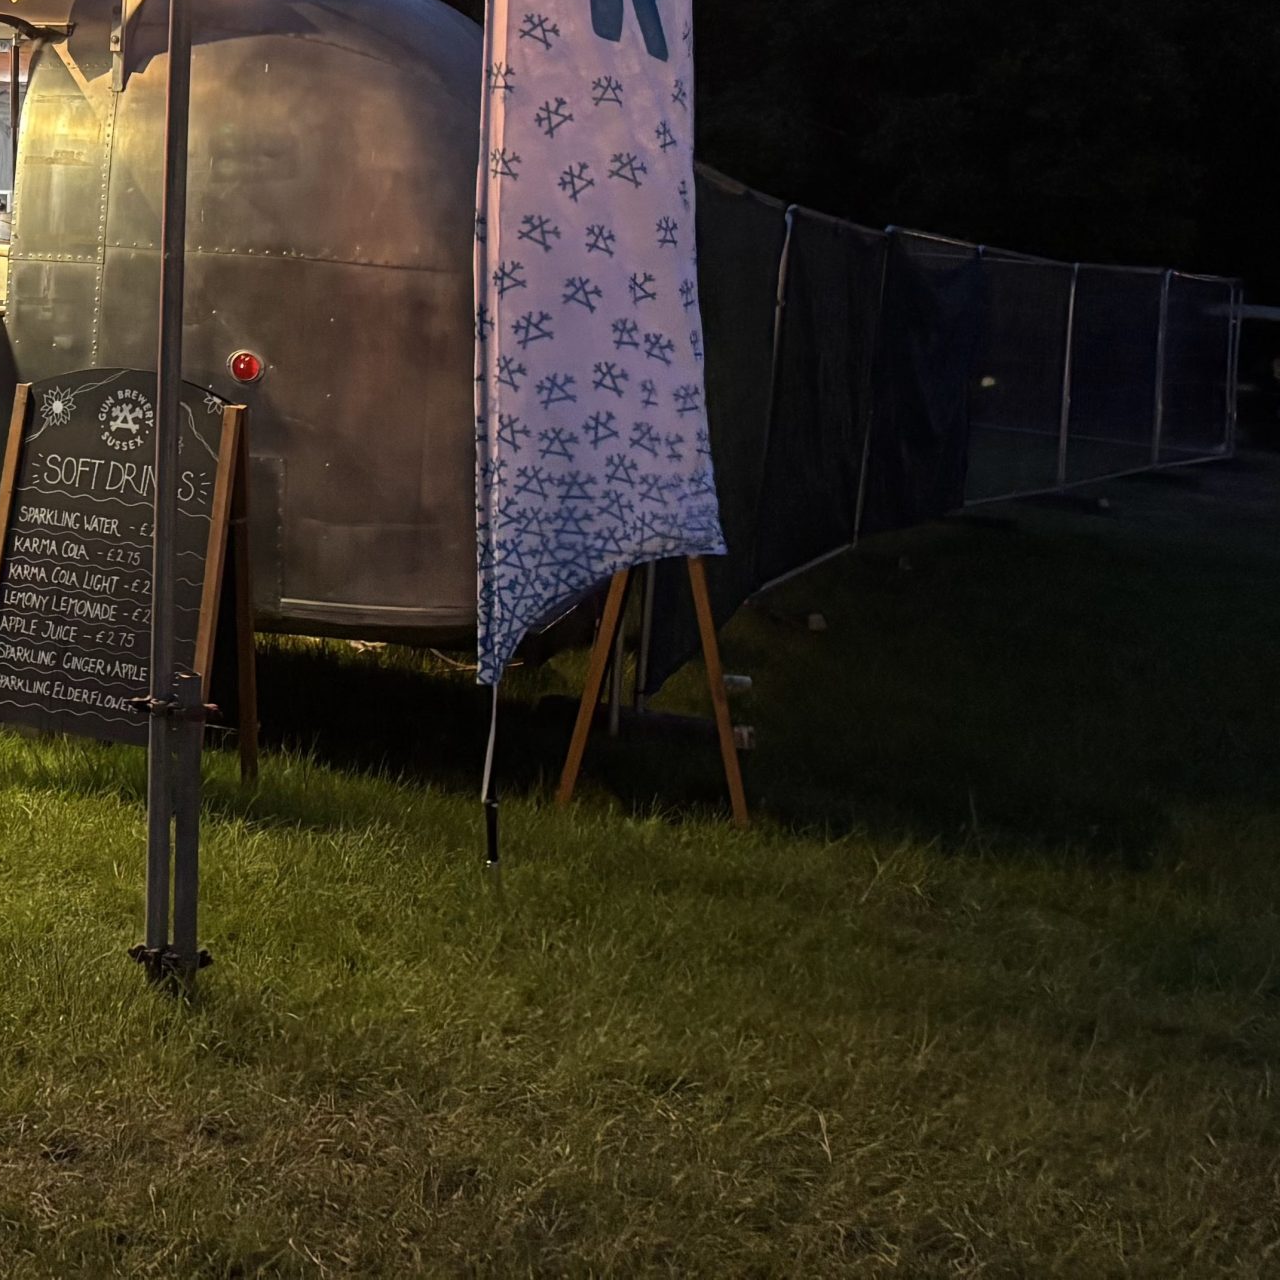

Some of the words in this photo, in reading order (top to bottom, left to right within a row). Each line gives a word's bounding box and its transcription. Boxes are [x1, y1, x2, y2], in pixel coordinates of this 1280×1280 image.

[98, 396, 115, 421] GUN
[117, 389, 154, 427] BREWERY
[101, 431, 144, 451] SUSSEX
[43, 454, 105, 490] SOFT
[105, 461, 194, 501] DRINS
[18, 506, 81, 530] SPARKLING
[83, 514, 121, 537] WATER
[13, 535, 58, 556] KARMA
[61, 540, 90, 561] COLA
[8, 562, 48, 583] KARMA
[51, 566, 80, 588] COLA
[82, 570, 120, 595] LIGHT
[3, 589, 50, 612] LEMONY
[51, 595, 118, 621] LEMONADE
[0, 615, 38, 636] APPLE
[41, 620, 78, 642] JUICE
[62, 652, 105, 676] GINGER
[111, 660, 148, 682] APPLE
